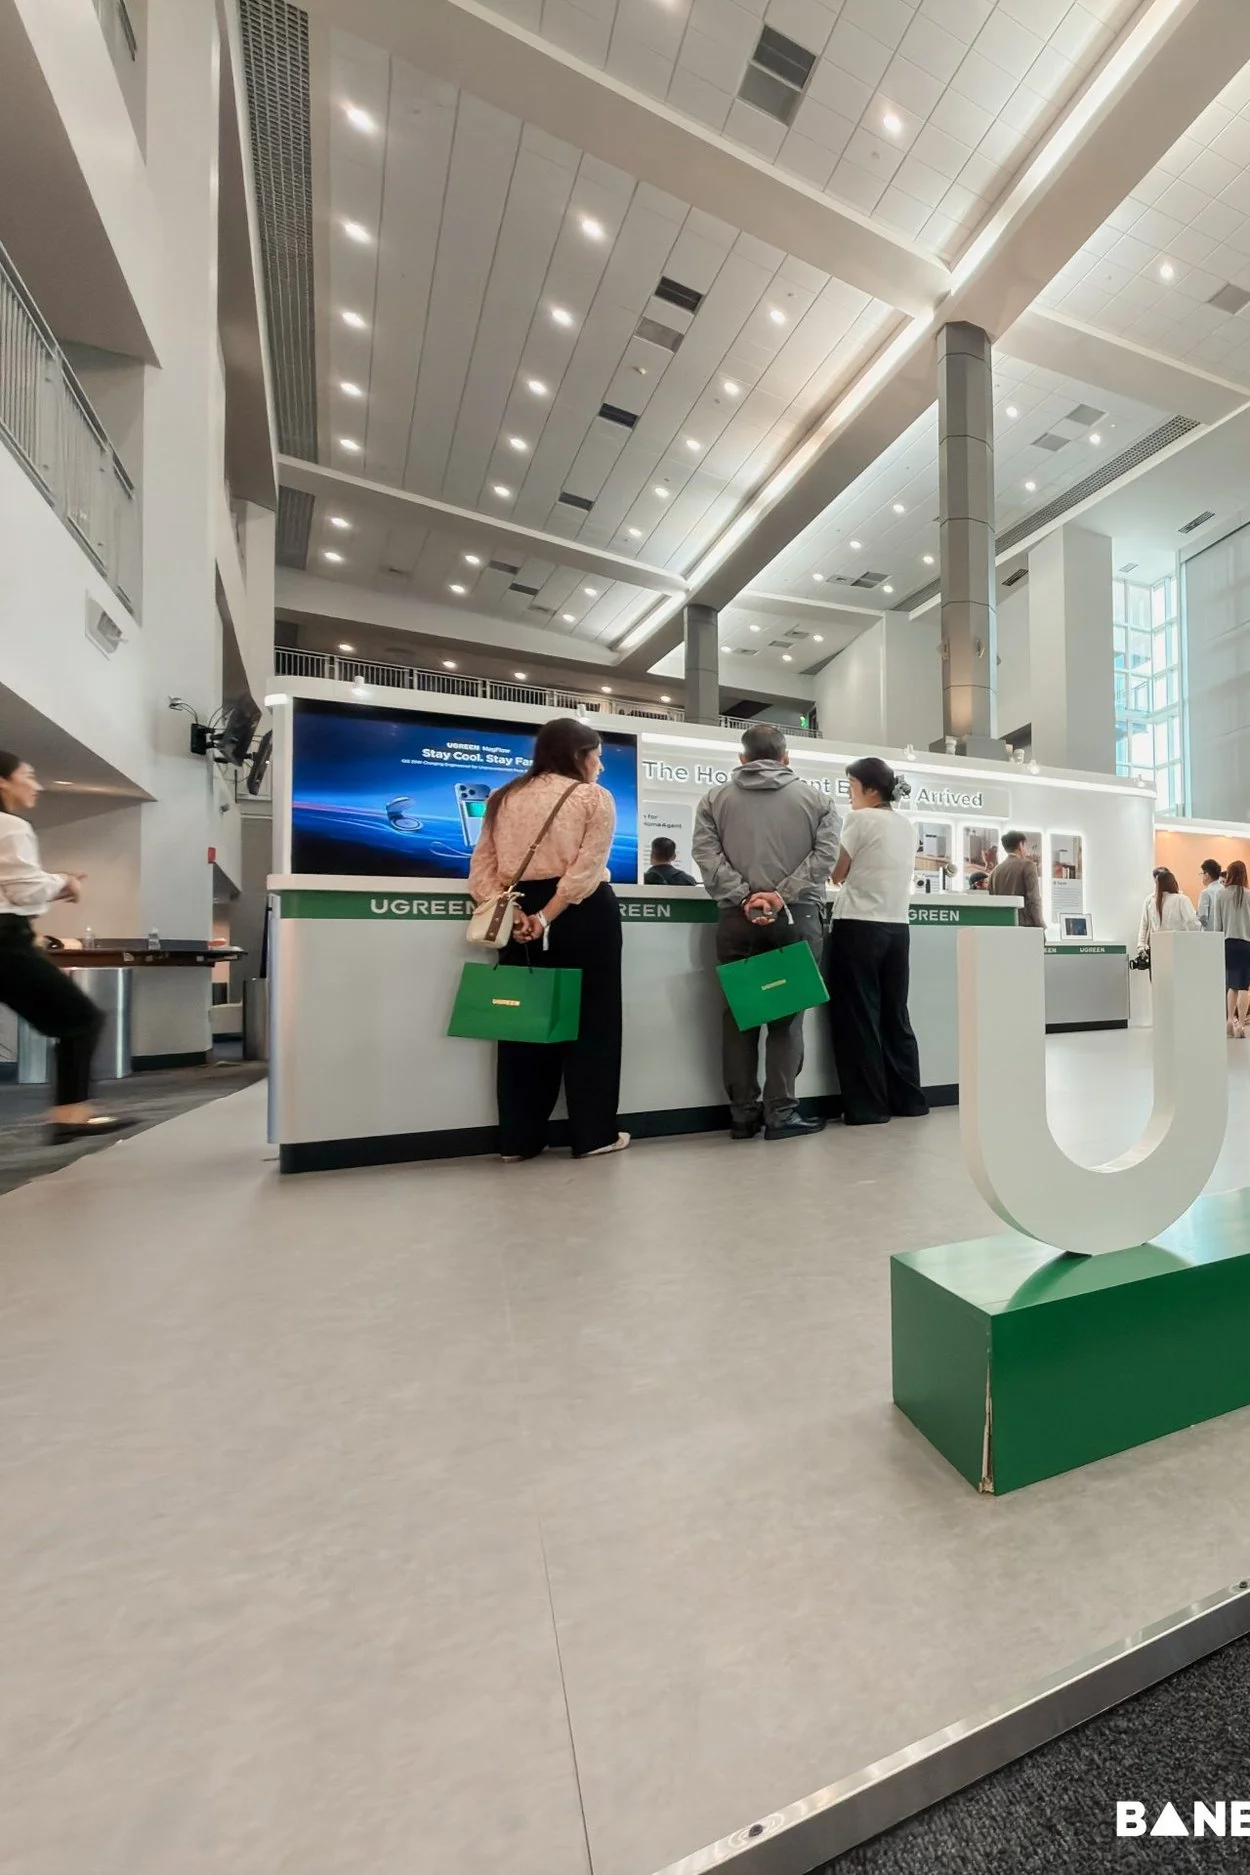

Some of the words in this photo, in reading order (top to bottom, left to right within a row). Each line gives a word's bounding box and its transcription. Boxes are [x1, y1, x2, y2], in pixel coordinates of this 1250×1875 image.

[446, 742, 480, 751] UGREEN
[422, 748, 451, 761] Stay
[453, 751, 483, 762] Cool.
[486, 754, 513, 766] Stay
[642, 760, 688, 780] The
[918, 788, 983, 806] Arrived
[619, 903, 671, 917] REEN
[909, 909, 960, 921] GREEN
